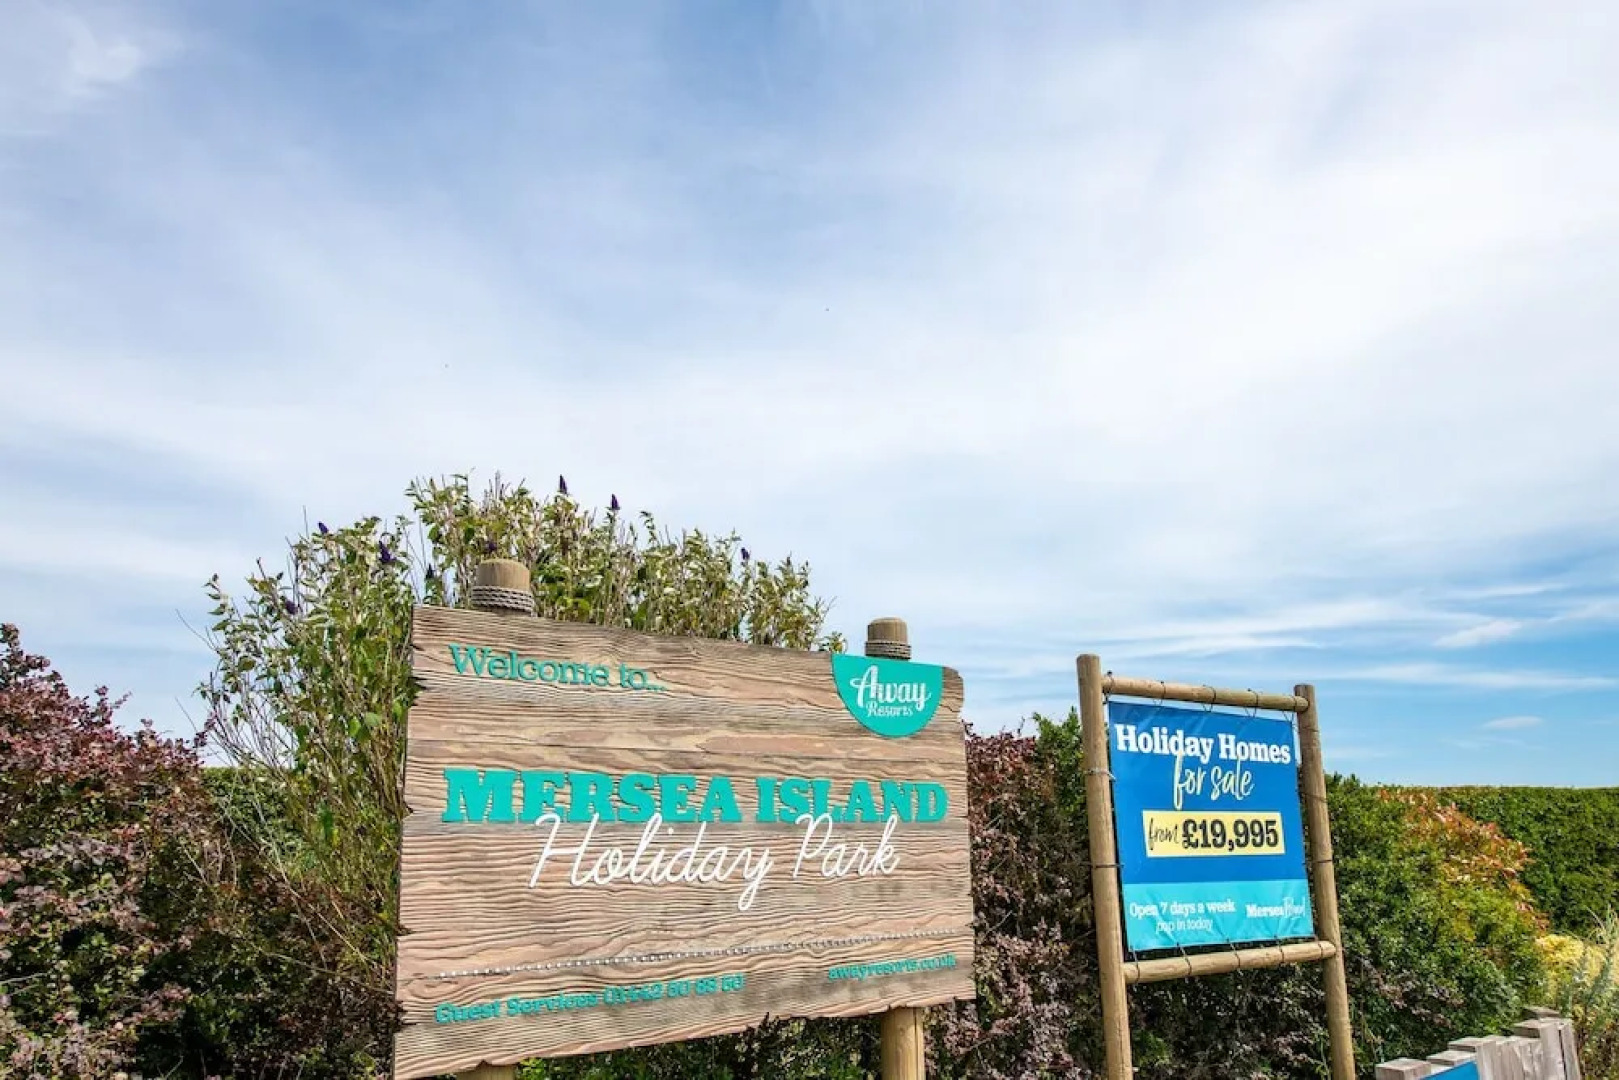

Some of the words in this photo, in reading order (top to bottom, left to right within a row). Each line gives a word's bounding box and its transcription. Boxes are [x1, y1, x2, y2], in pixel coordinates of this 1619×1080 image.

[448, 643, 610, 686] Welcome
[850, 664, 932, 711] Away
[866, 700, 913, 717] Resorts
[1114, 723, 1214, 764] Holiday
[1217, 733, 1291, 764] Homes
[442, 768, 742, 824] MERSEA
[755, 776, 948, 823] ISLAND
[1173, 755, 1207, 810] for
[1210, 757, 1255, 801] sale
[1149, 817, 1178, 851] from
[1181, 818, 1280, 852] £19,995
[528, 811, 774, 911] Holiday
[791, 812, 899, 879] Park
[1129, 902, 1158, 918] Open
[1160, 902, 1168, 914] 7
[1170, 901, 1196, 917] days
[1198, 902, 1205, 914] a
[1206, 898, 1237, 914] week
[1156, 921, 1175, 934] pop
[1176, 920, 1186, 931] in
[1186, 918, 1214, 932] today
[828, 952, 957, 981] awayresorts.co.uk
[435, 1001, 500, 1023] Guest
[506, 995, 598, 1015] Services
